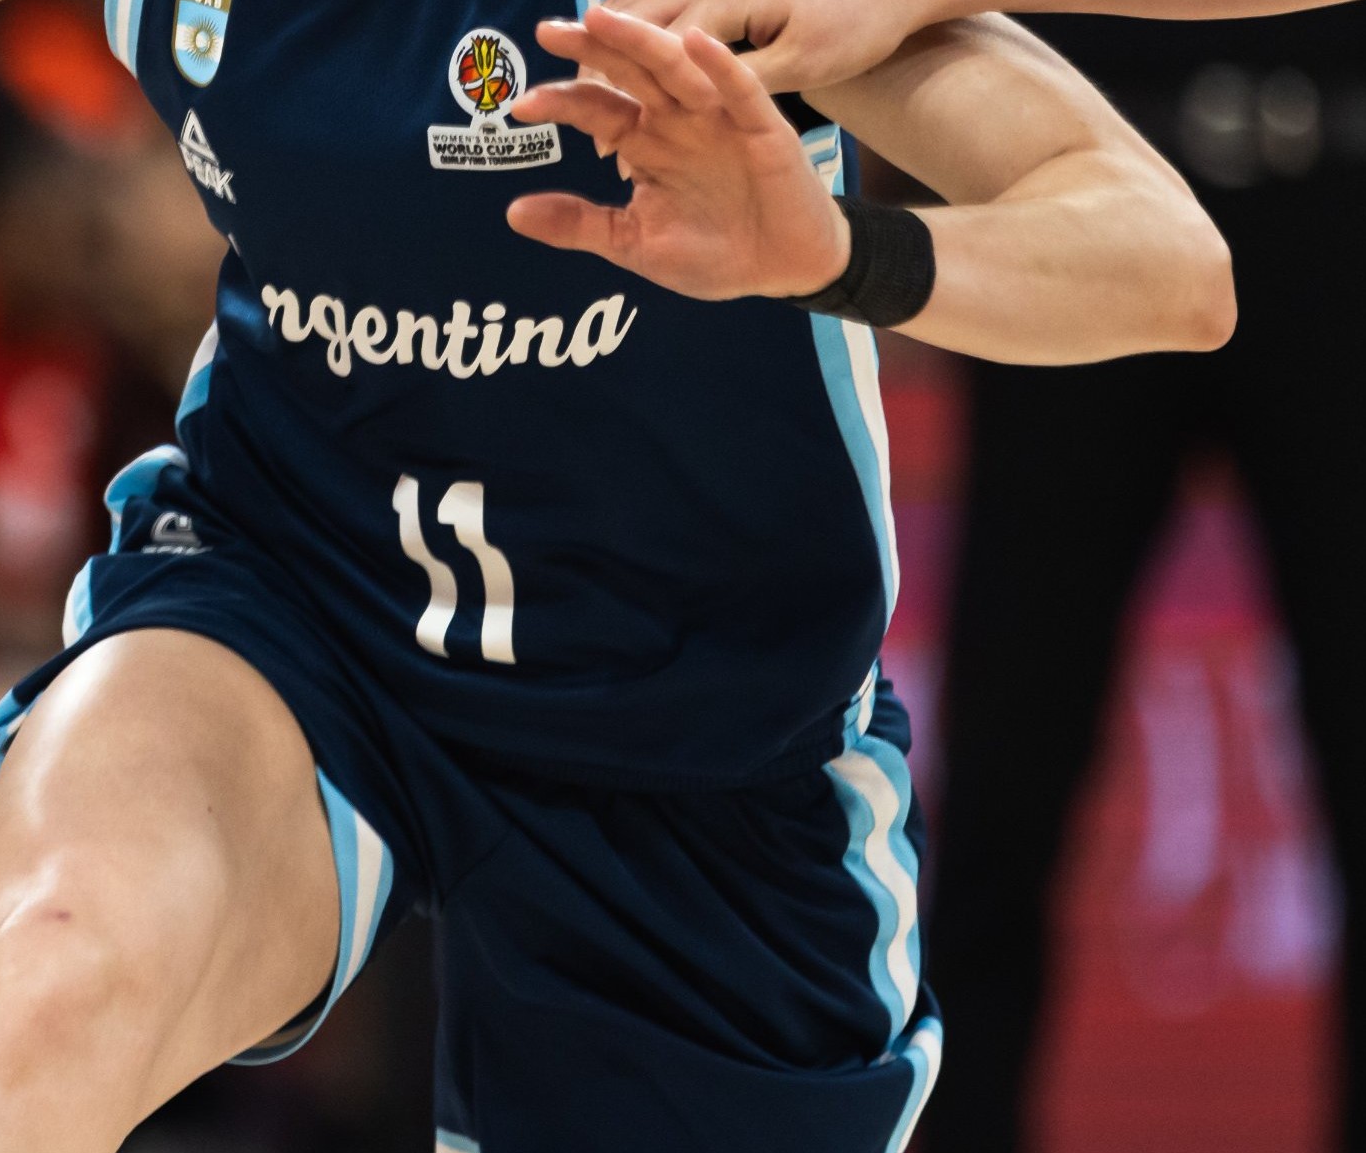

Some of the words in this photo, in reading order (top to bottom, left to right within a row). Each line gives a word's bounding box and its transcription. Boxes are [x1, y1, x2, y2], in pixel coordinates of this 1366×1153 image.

[433, 134, 480, 144] WOMEN'S
[484, 131, 553, 144] BASKETBALL
[433, 143, 483, 156] WORLD
[487, 145, 515, 156] CUP
[519, 138, 554, 154] 2026
[261, 284, 637, 378] rgentina
[392, 473, 516, 664] 11
